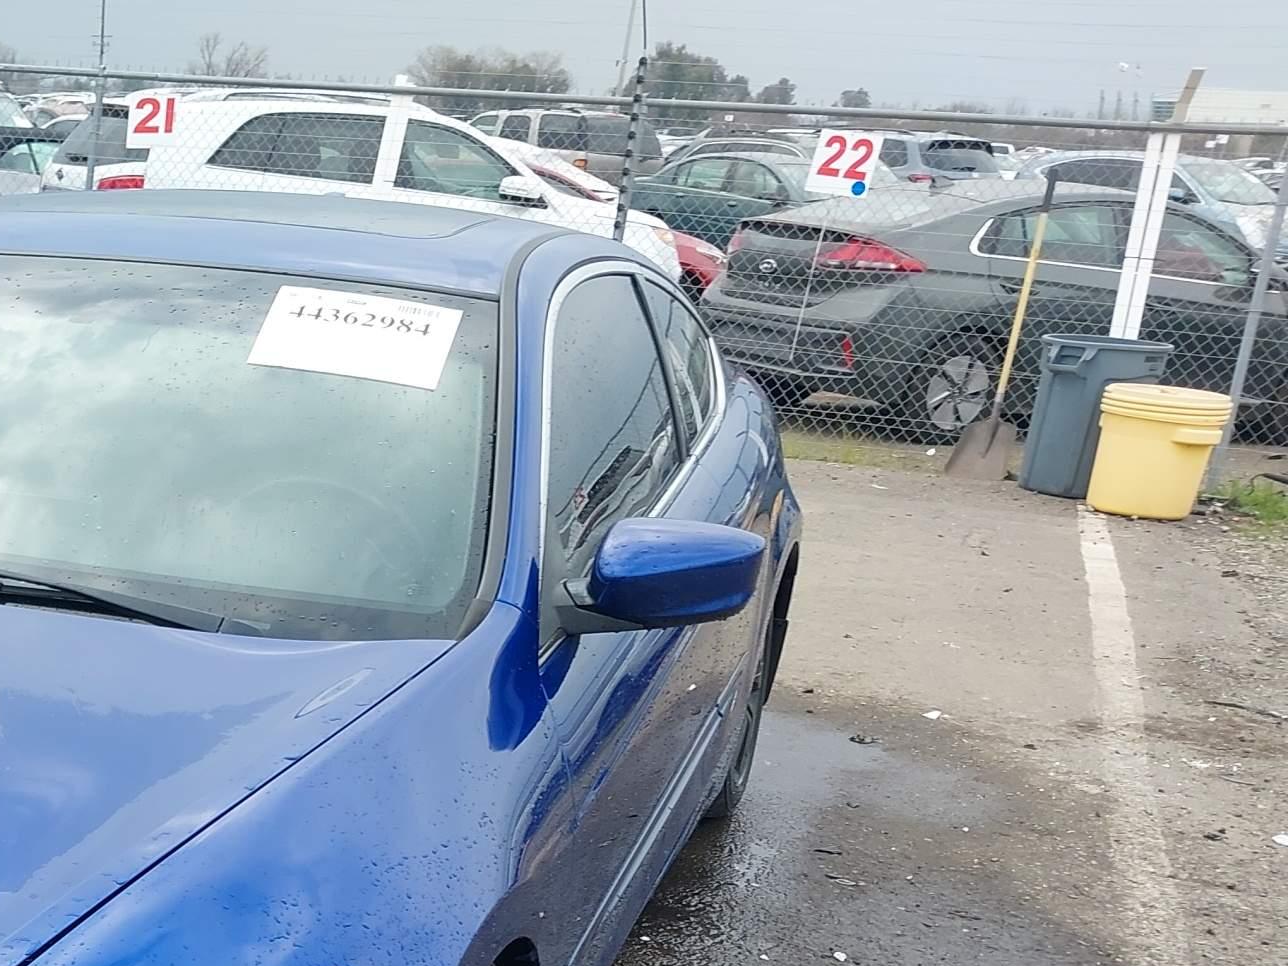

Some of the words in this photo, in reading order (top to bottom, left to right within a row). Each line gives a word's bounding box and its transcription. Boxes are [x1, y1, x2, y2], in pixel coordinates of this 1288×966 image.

[133, 98, 175, 133] 21
[816, 135, 874, 181] 22
[288, 304, 431, 337] 44362984
